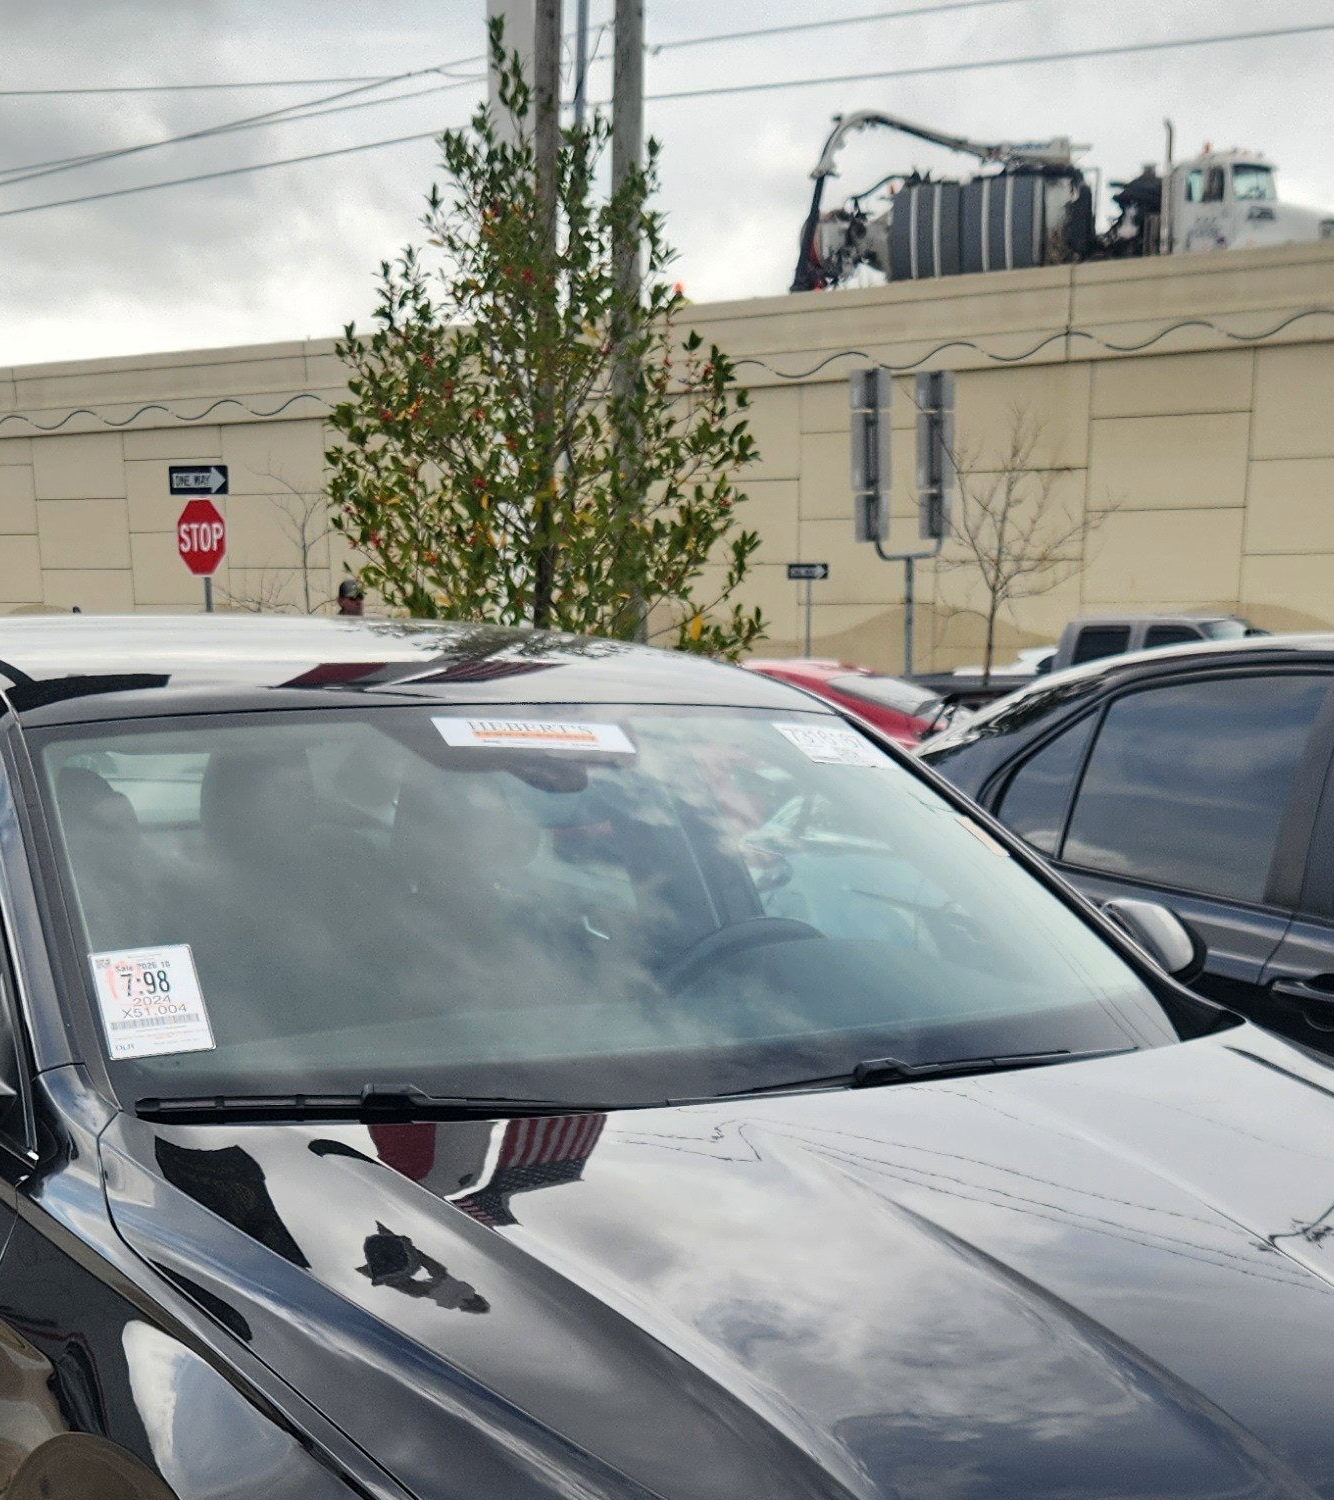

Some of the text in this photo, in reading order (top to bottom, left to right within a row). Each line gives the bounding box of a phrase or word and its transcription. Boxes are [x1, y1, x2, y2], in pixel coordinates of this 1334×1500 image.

[175, 475, 210, 487] ONE WAY
[180, 522, 223, 553] STOP
[132, 994, 171, 1007] 2024
